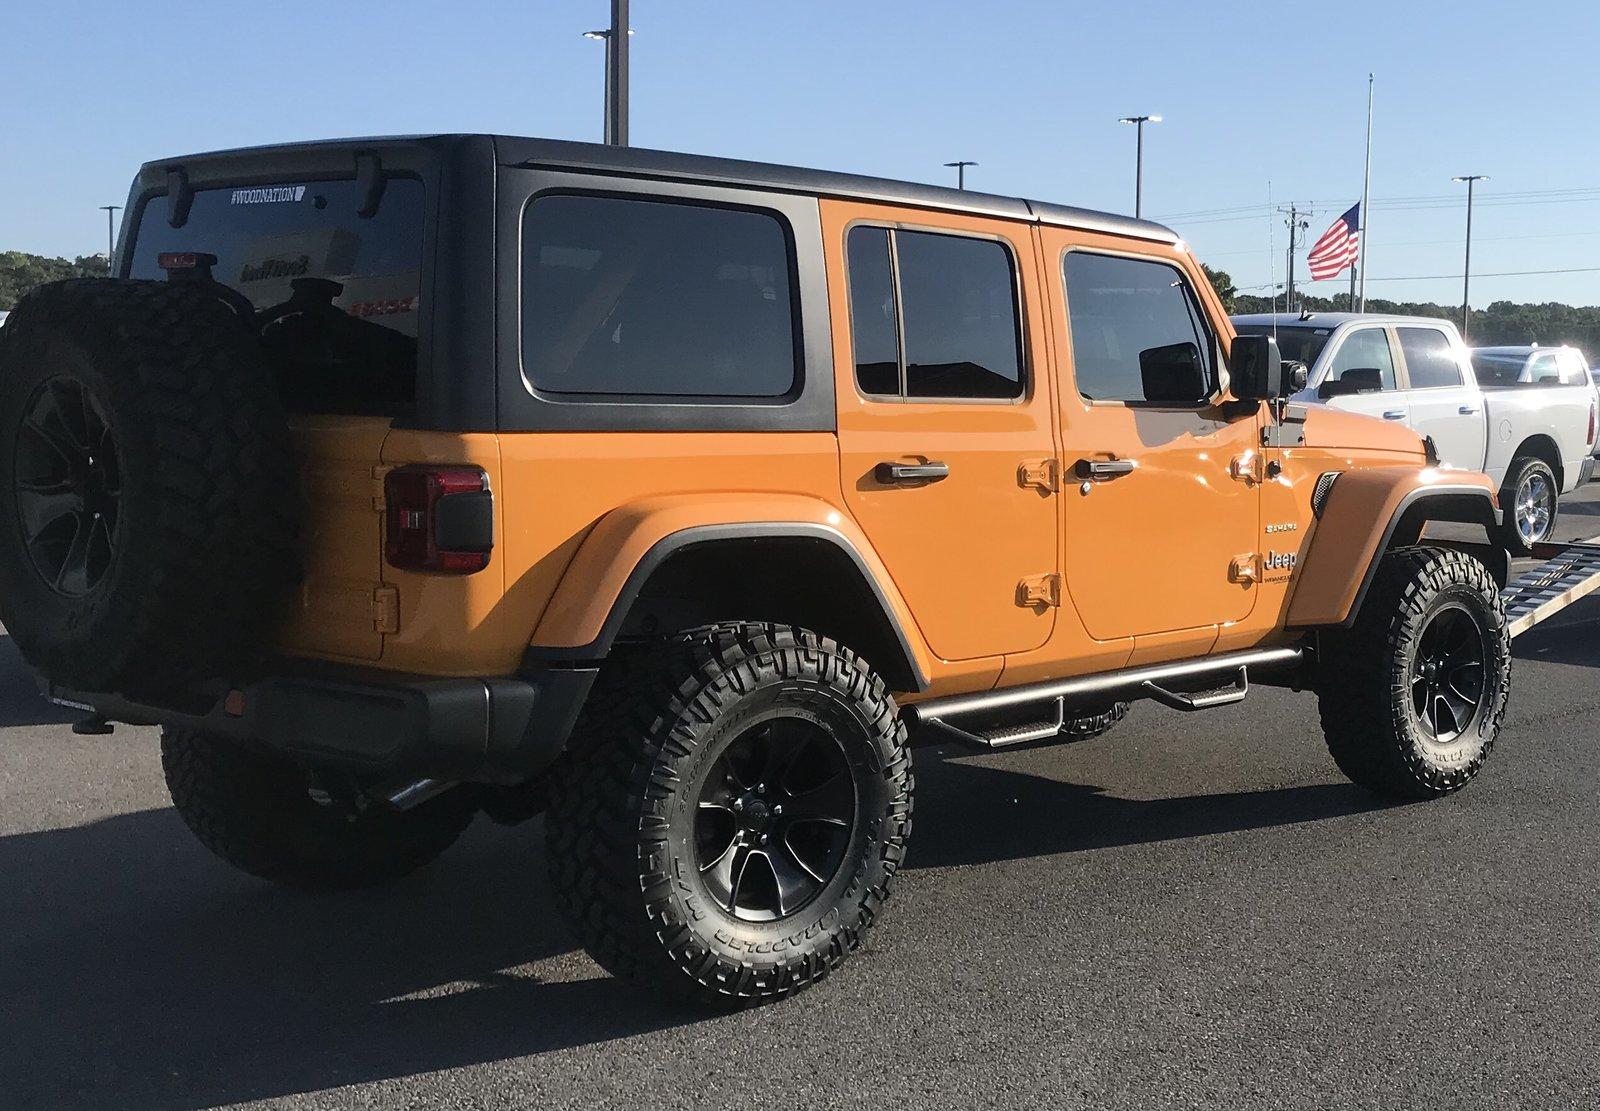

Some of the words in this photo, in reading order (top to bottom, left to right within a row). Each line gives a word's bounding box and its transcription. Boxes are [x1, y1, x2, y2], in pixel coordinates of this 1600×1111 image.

[230, 187, 295, 204] #WOODNATION
[1264, 550, 1297, 571] Jeep
[714, 907, 839, 954] GRAPPLER
